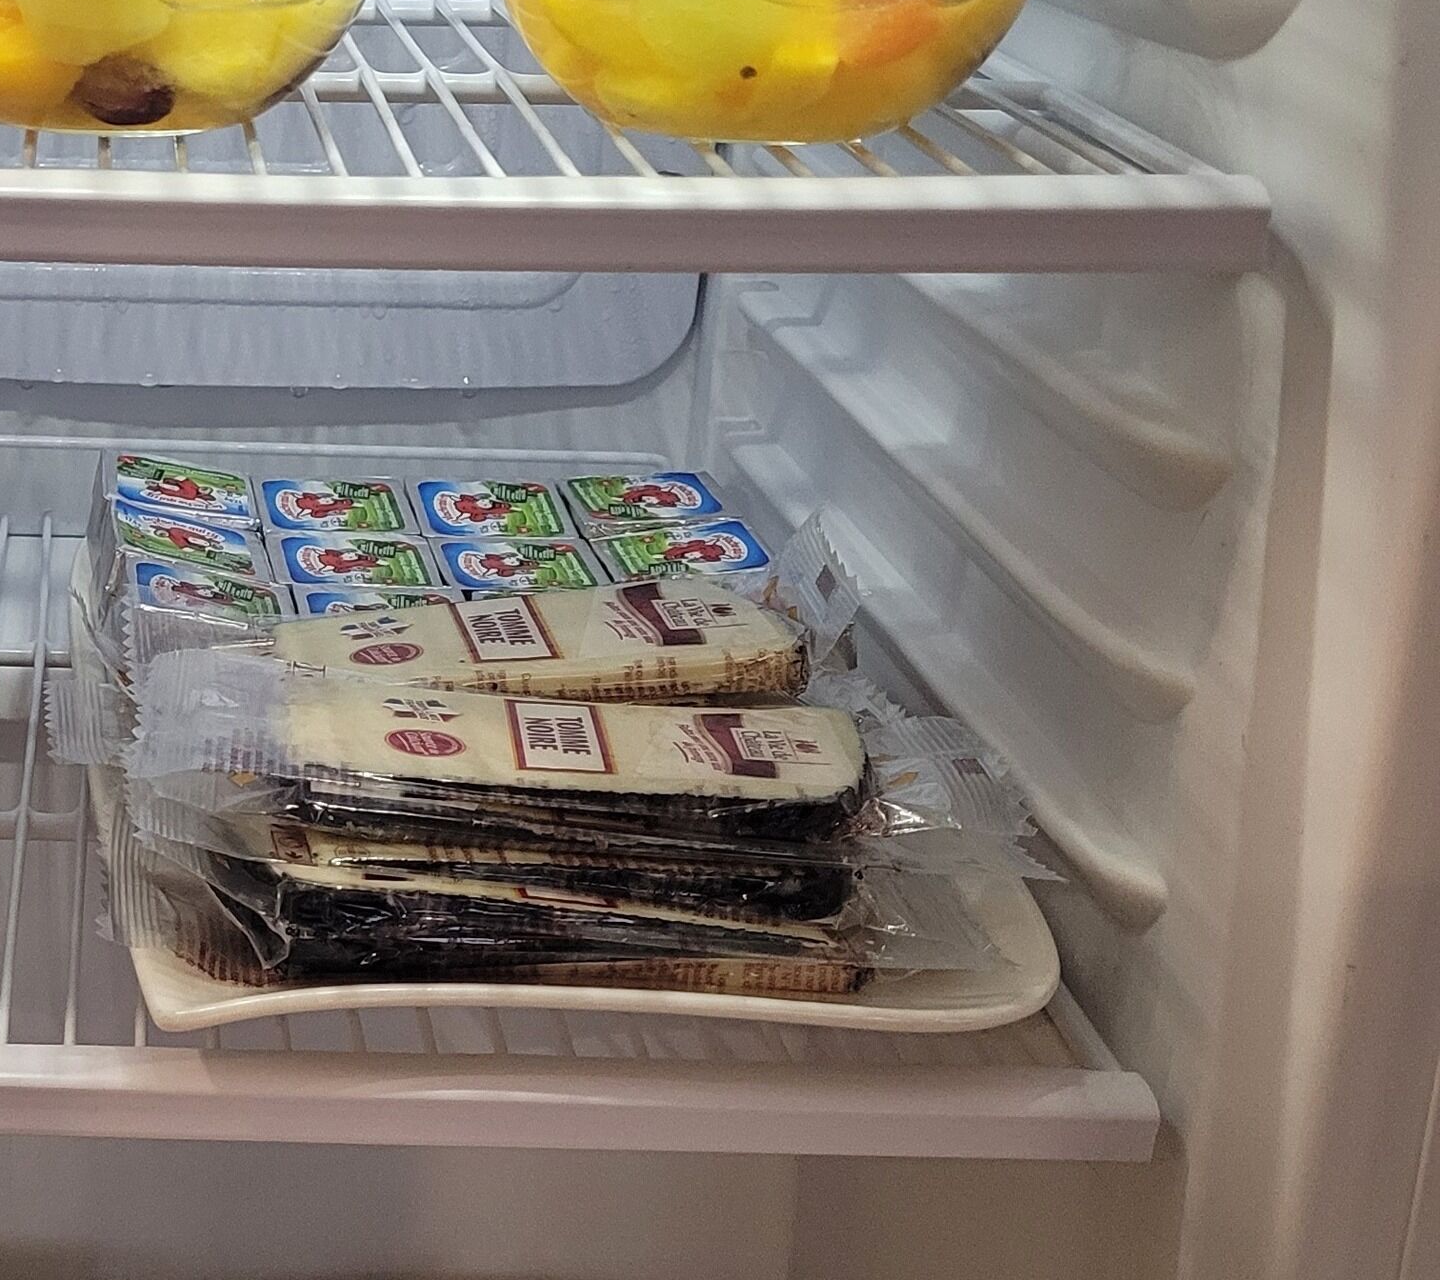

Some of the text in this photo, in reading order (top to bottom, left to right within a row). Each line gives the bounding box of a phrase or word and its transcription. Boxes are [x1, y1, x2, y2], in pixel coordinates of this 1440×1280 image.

[468, 614, 506, 645] NOIRE
[494, 608, 536, 646] TOMME
[524, 717, 559, 752] NOIRE
[556, 716, 592, 756] TOMME
